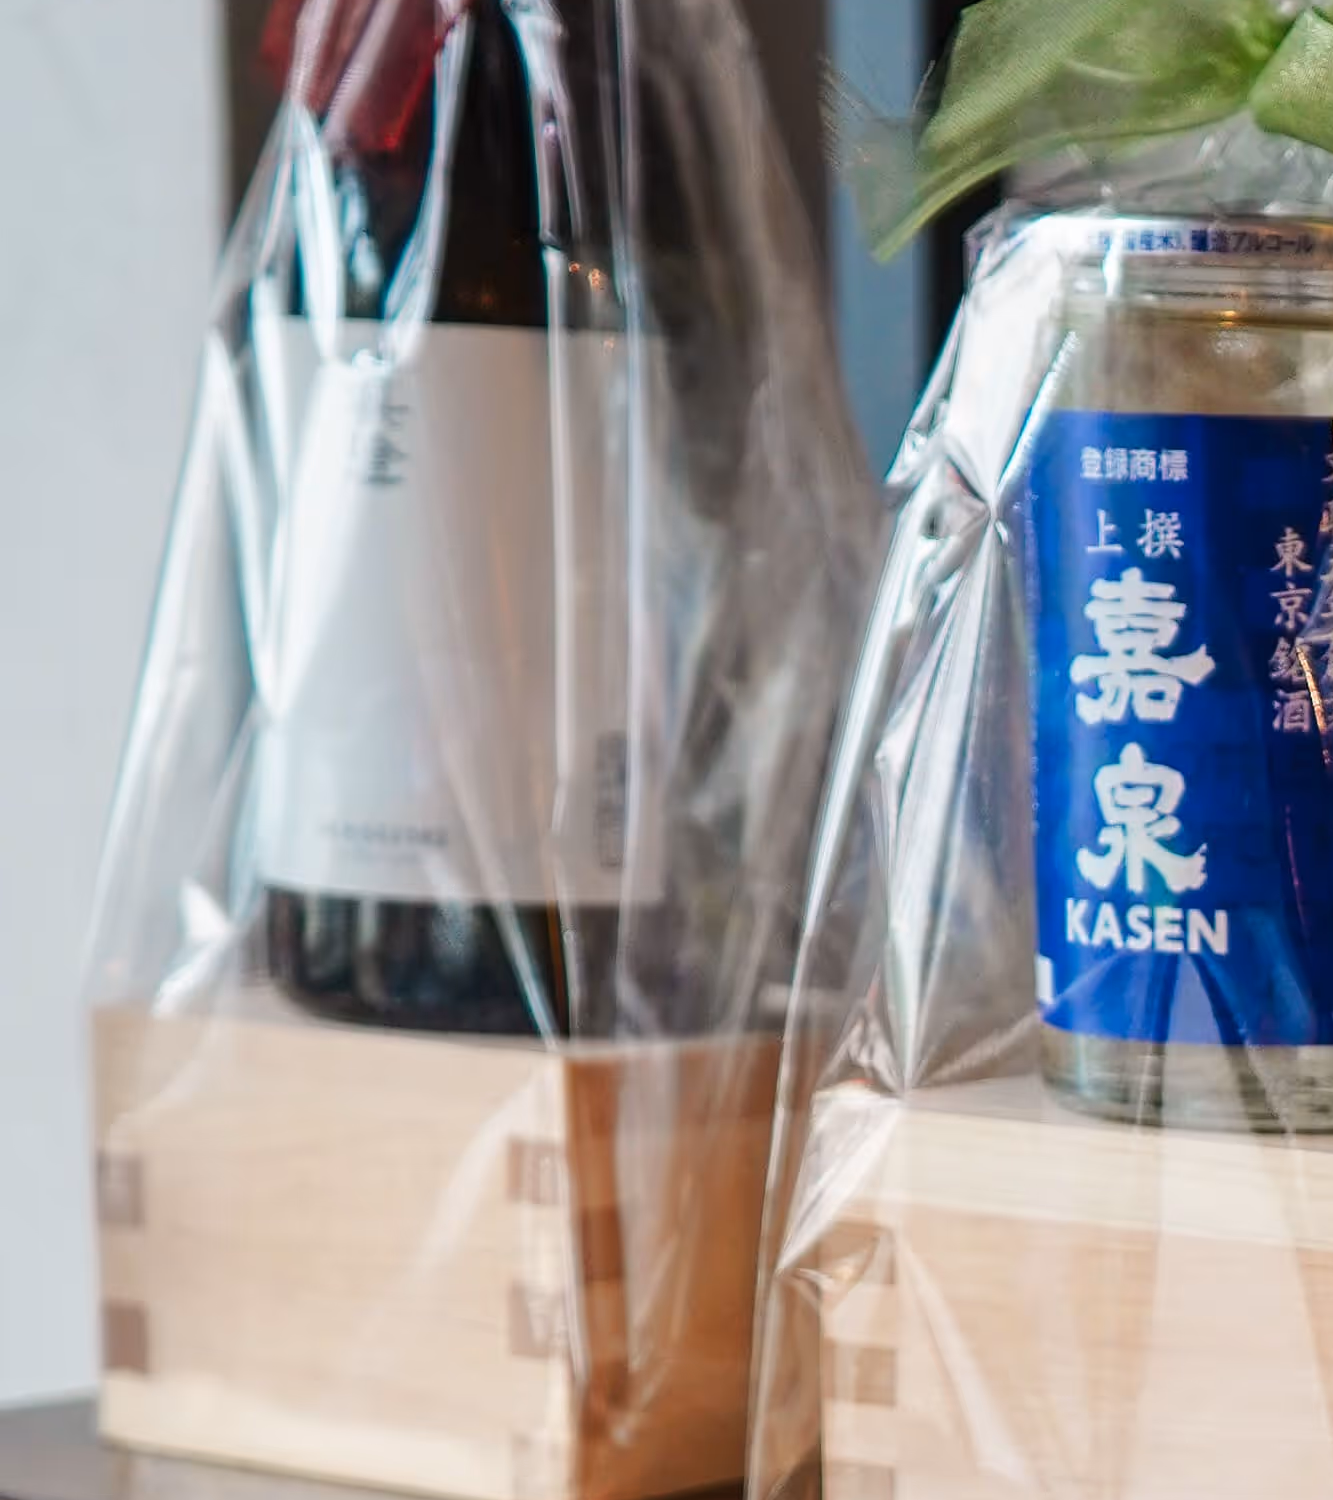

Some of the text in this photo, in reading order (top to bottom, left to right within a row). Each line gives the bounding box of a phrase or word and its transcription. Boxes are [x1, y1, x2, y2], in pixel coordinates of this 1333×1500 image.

[1079, 445, 1190, 484] 登録商標
[1085, 508, 1185, 561] 上撰
[1269, 526, 1315, 734] 東京銘酒
[1069, 566, 1217, 895] 嘉泉
[1064, 897, 1229, 957] KASEN
